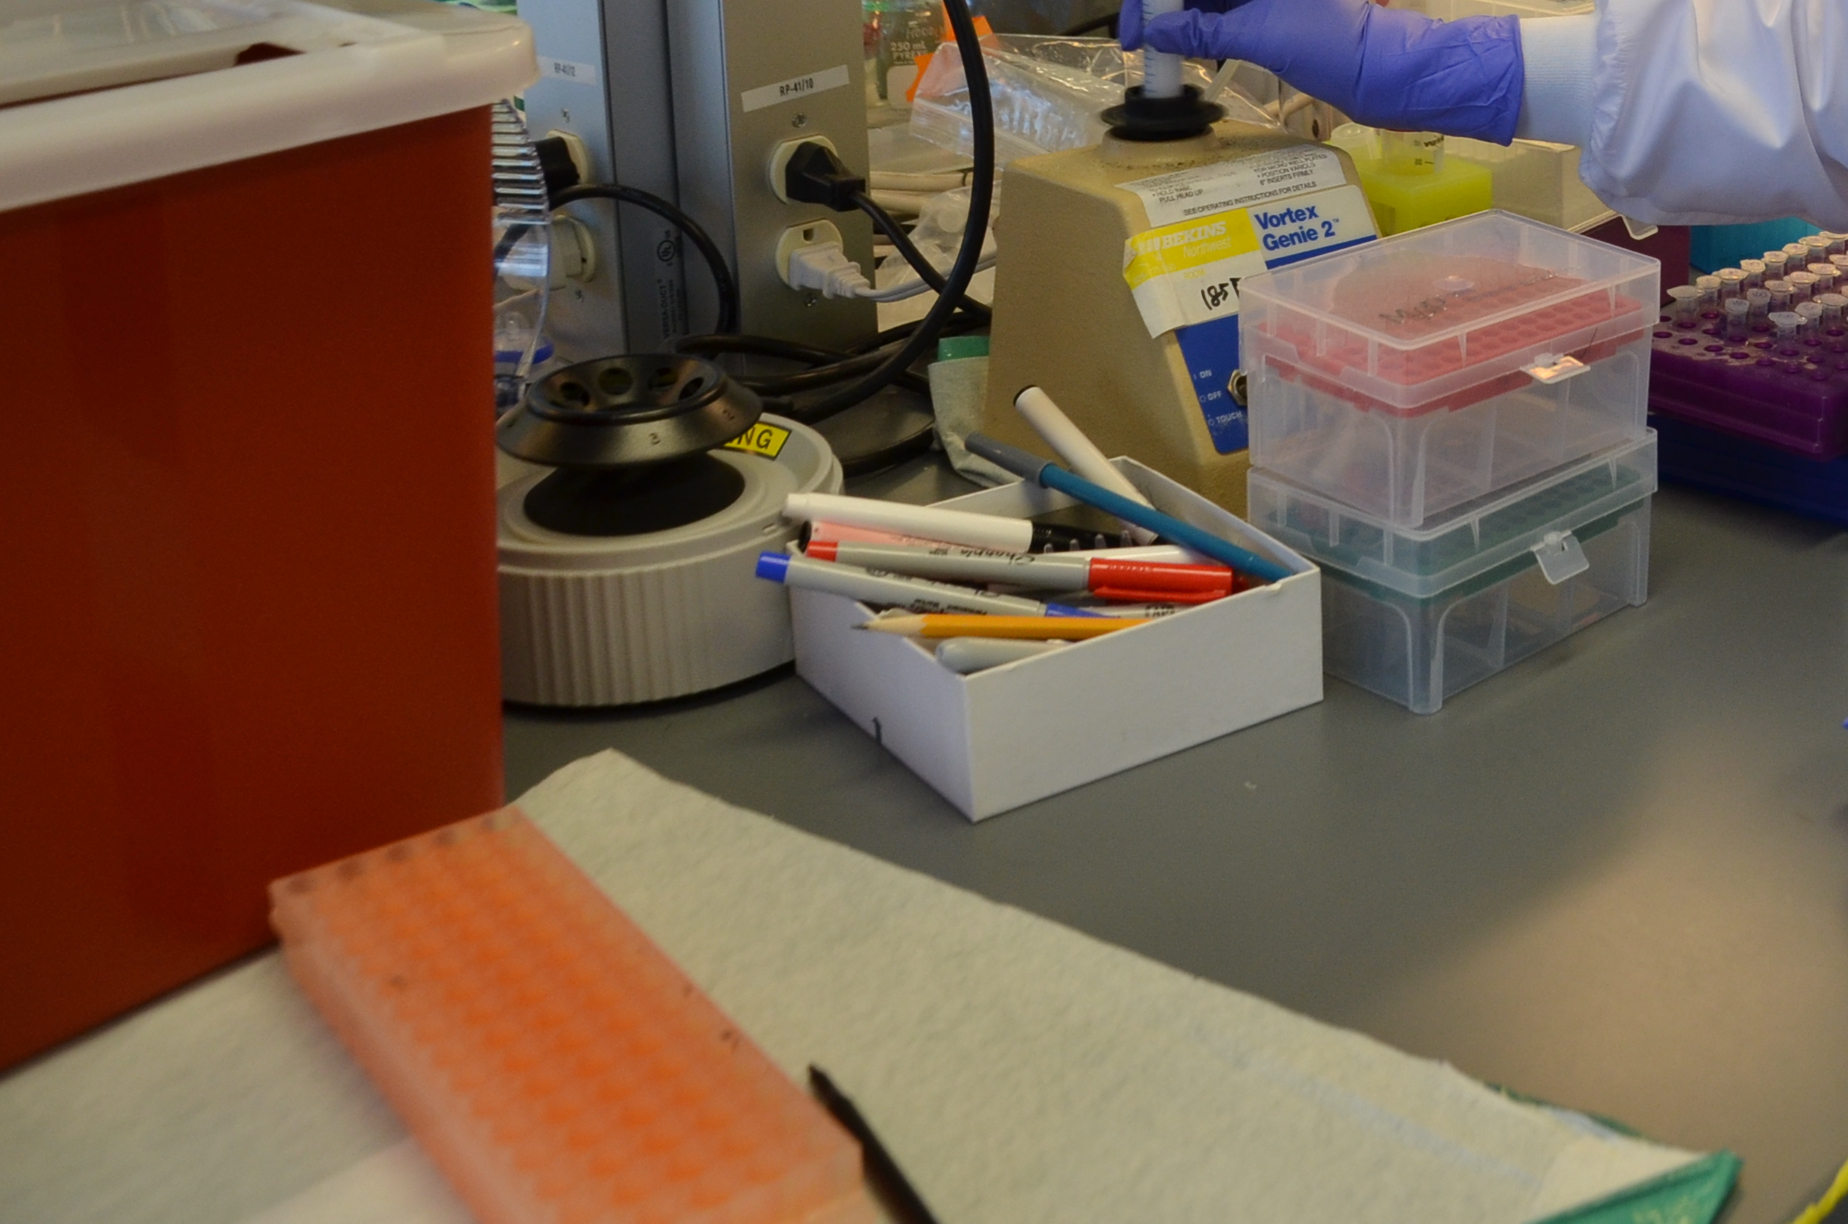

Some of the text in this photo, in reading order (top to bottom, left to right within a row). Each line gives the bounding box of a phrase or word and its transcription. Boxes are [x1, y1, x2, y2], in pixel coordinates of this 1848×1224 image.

[890, 41, 911, 52] 250
[779, 77, 814, 97] RP-41/10
[1261, 169, 1287, 178] POSITION
[1267, 174, 1293, 184] INSERTS
[1159, 196, 1176, 204] PULL
[1194, 188, 1204, 196] UP
[1183, 181, 1317, 216] SEE OPERATING INSTRUCTIONS FOR DETAILS
[1254, 203, 1320, 231] Vortex
[1162, 220, 1228, 250] BEKINS
[1261, 226, 1319, 252] Genie
[1182, 236, 1232, 259] Northwest
[1199, 368, 1213, 379] ON
[1207, 390, 1222, 401] OFF
[1215, 410, 1243, 424] TOUCH
[735, 426, 774, 451] NG
